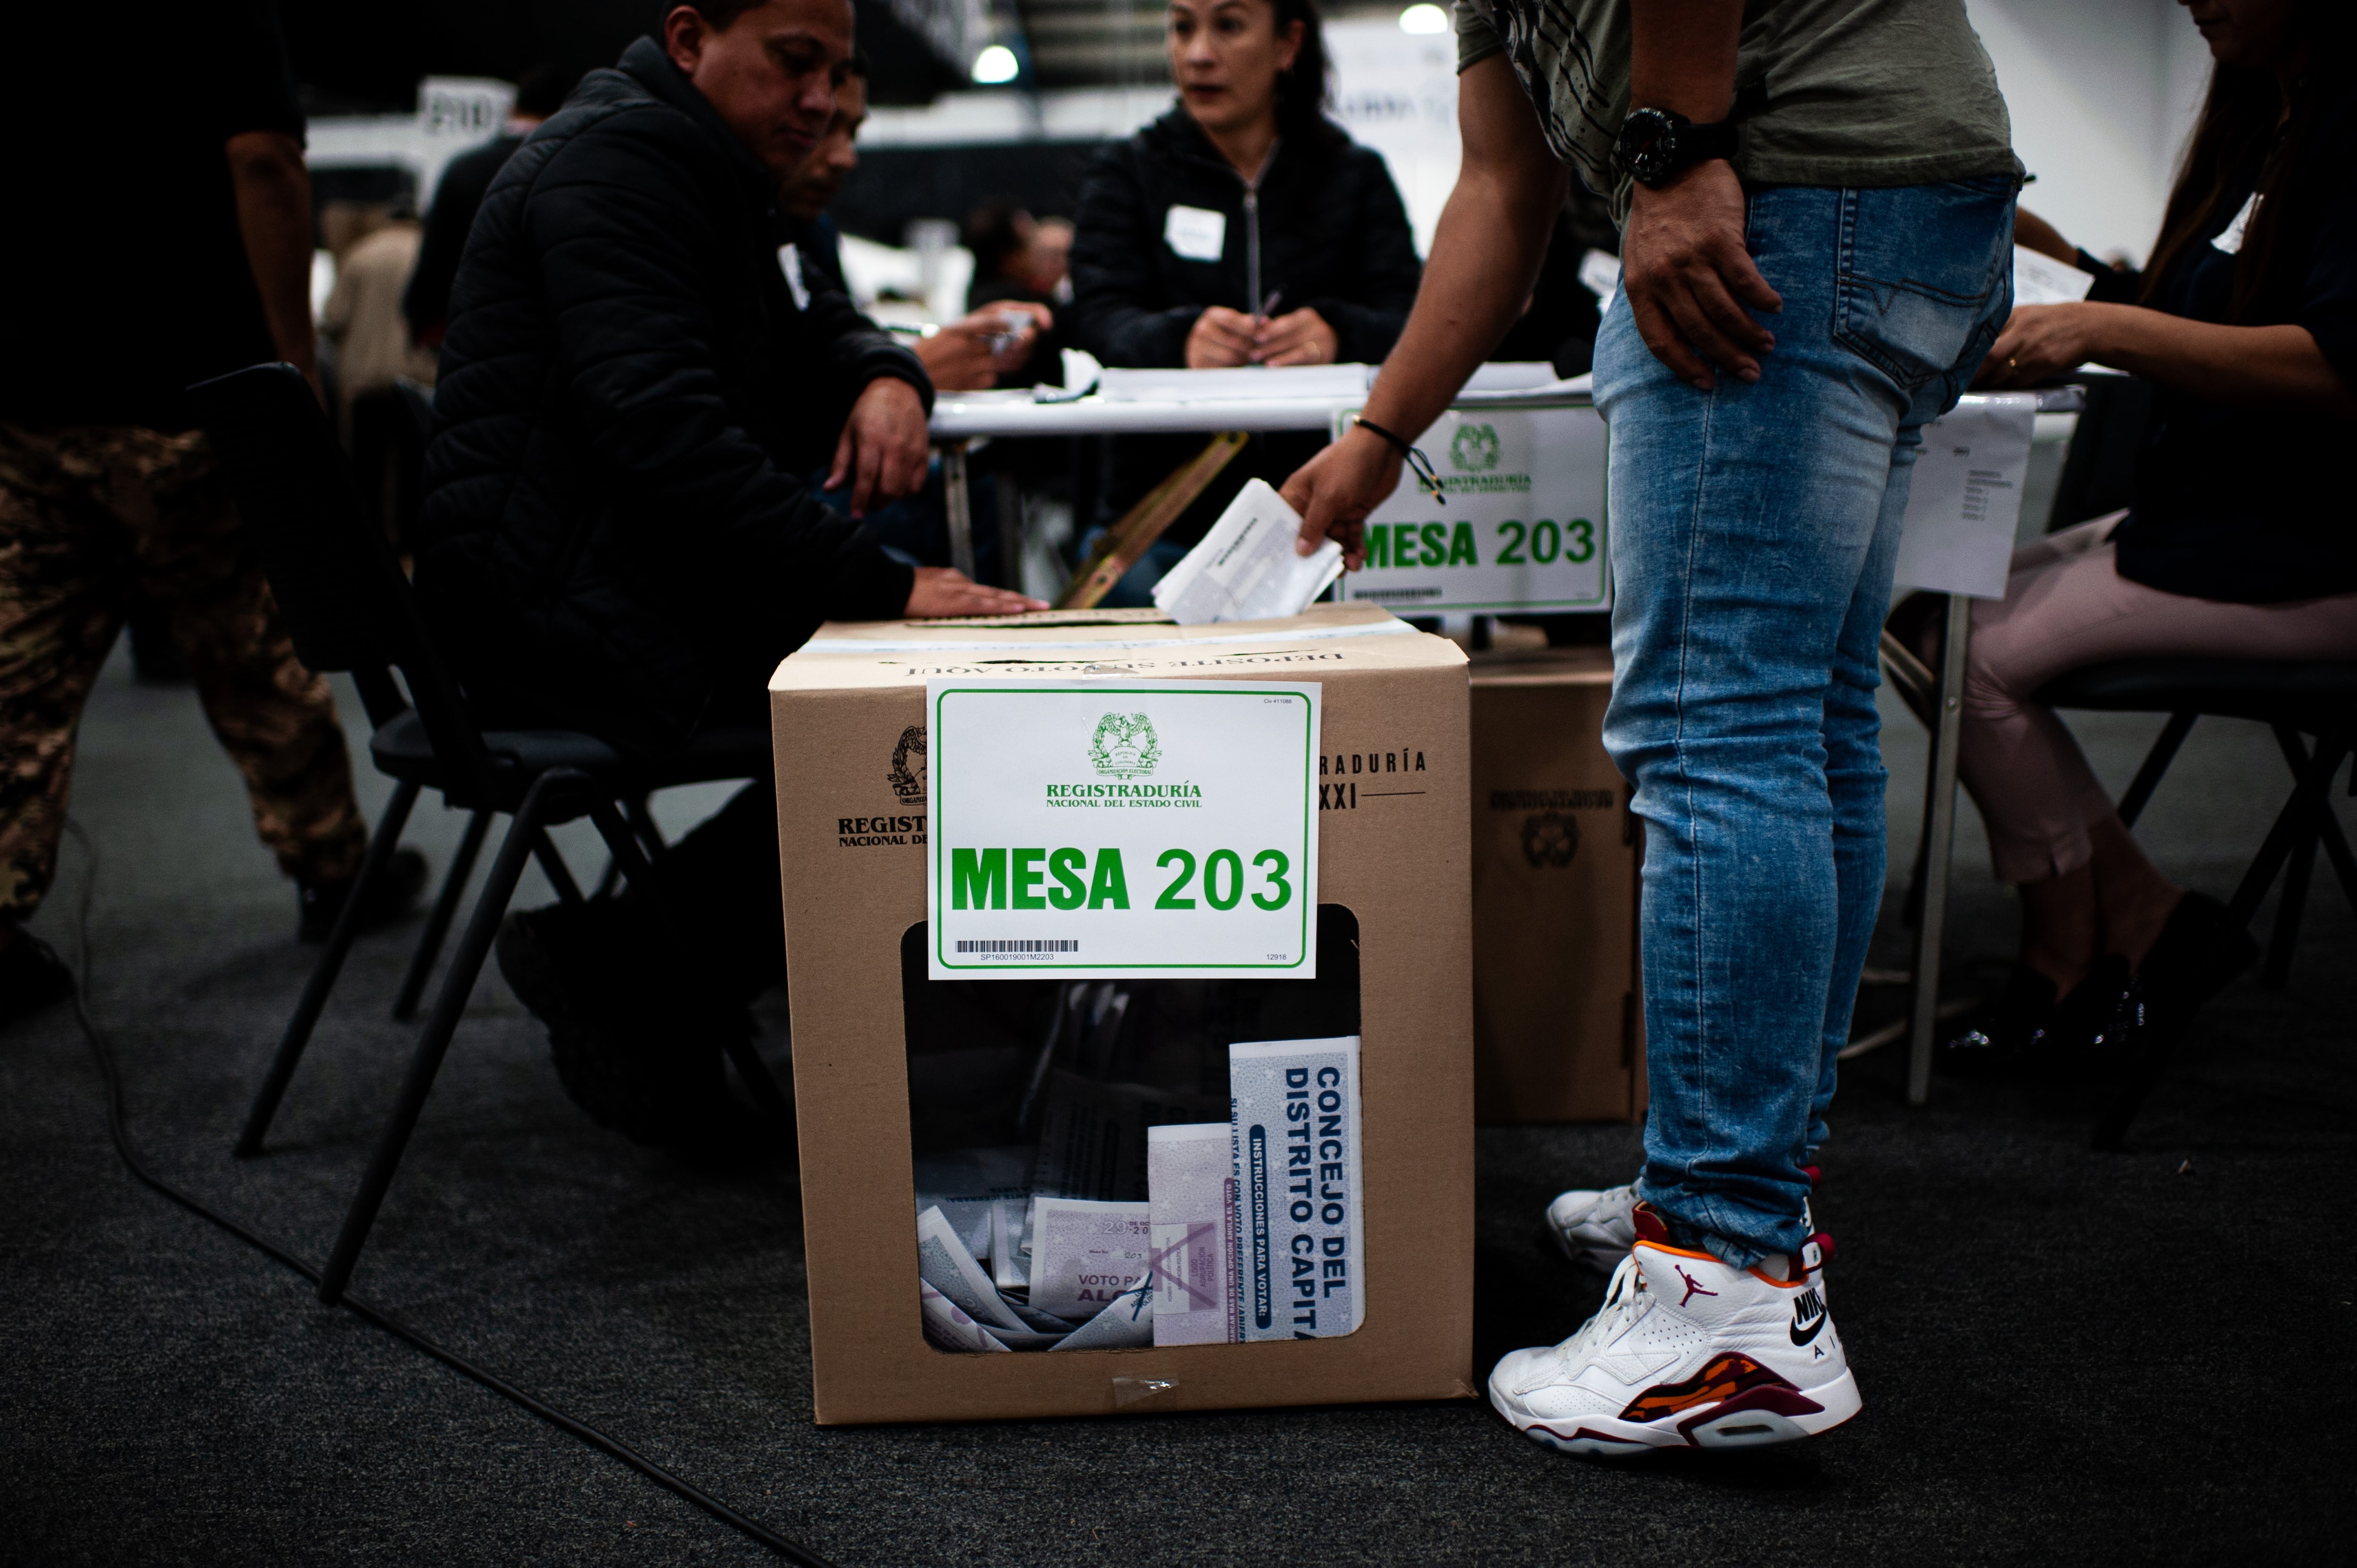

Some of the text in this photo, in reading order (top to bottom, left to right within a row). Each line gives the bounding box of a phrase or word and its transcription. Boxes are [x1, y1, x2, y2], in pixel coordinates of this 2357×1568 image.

[1496, 518, 1595, 564] 203
[1168, 653, 1343, 668] DEPOSITE
[1047, 780, 1202, 797] REGISTRADURÍA
[839, 836, 907, 847] NACIONAL
[952, 847, 1292, 911] MESA 203
[1286, 1067, 1313, 1223] DISTRITO
[1318, 1067, 1346, 1298] CONCEJO DEL
[1227, 1206, 1232, 1215] EL
[1102, 1221, 1127, 1235] 29
[1253, 1138, 1267, 1316] INSTRUCCIONES PARA VOTAR:
[1079, 1275, 1119, 1286] VOTO
[1229, 1288, 1234, 1296] DE
